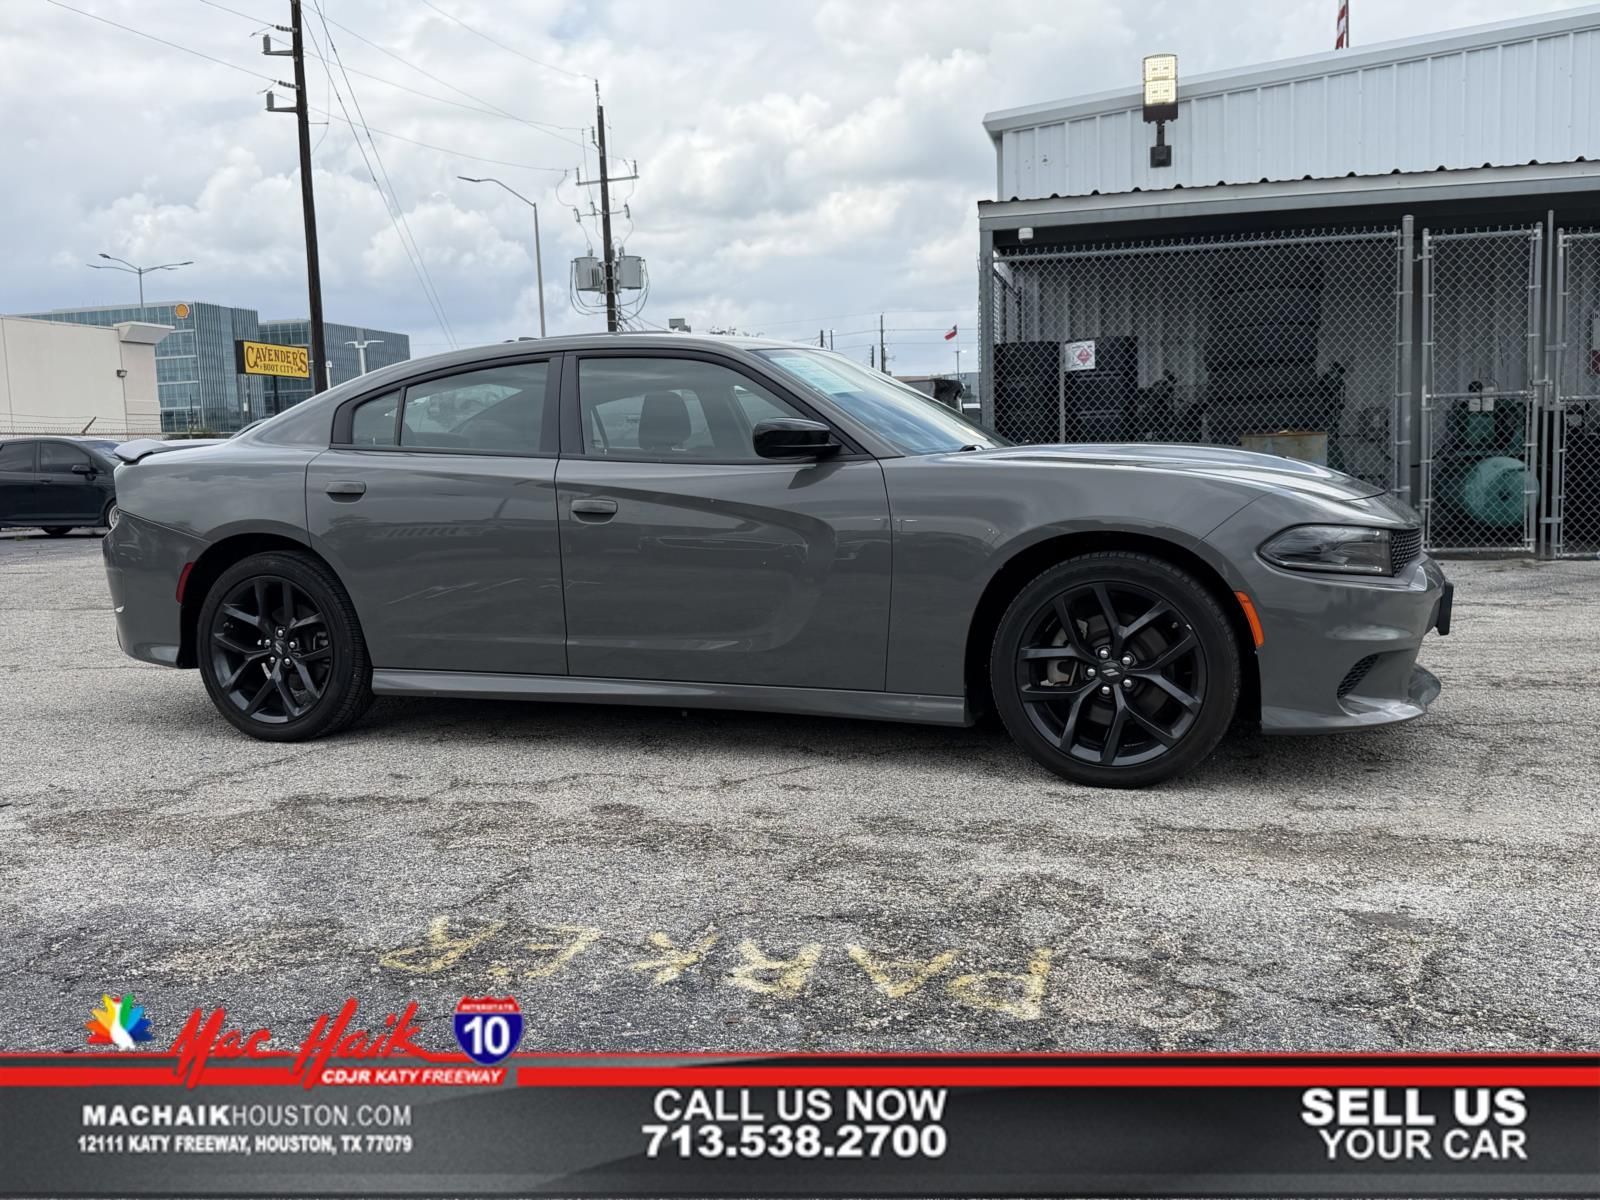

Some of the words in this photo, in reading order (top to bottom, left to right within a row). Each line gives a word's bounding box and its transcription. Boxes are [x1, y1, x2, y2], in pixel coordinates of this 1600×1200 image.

[246, 345, 307, 374] CAVENDER'S
[263, 363, 278, 372] BOOT
[280, 365, 293, 374] CITY
